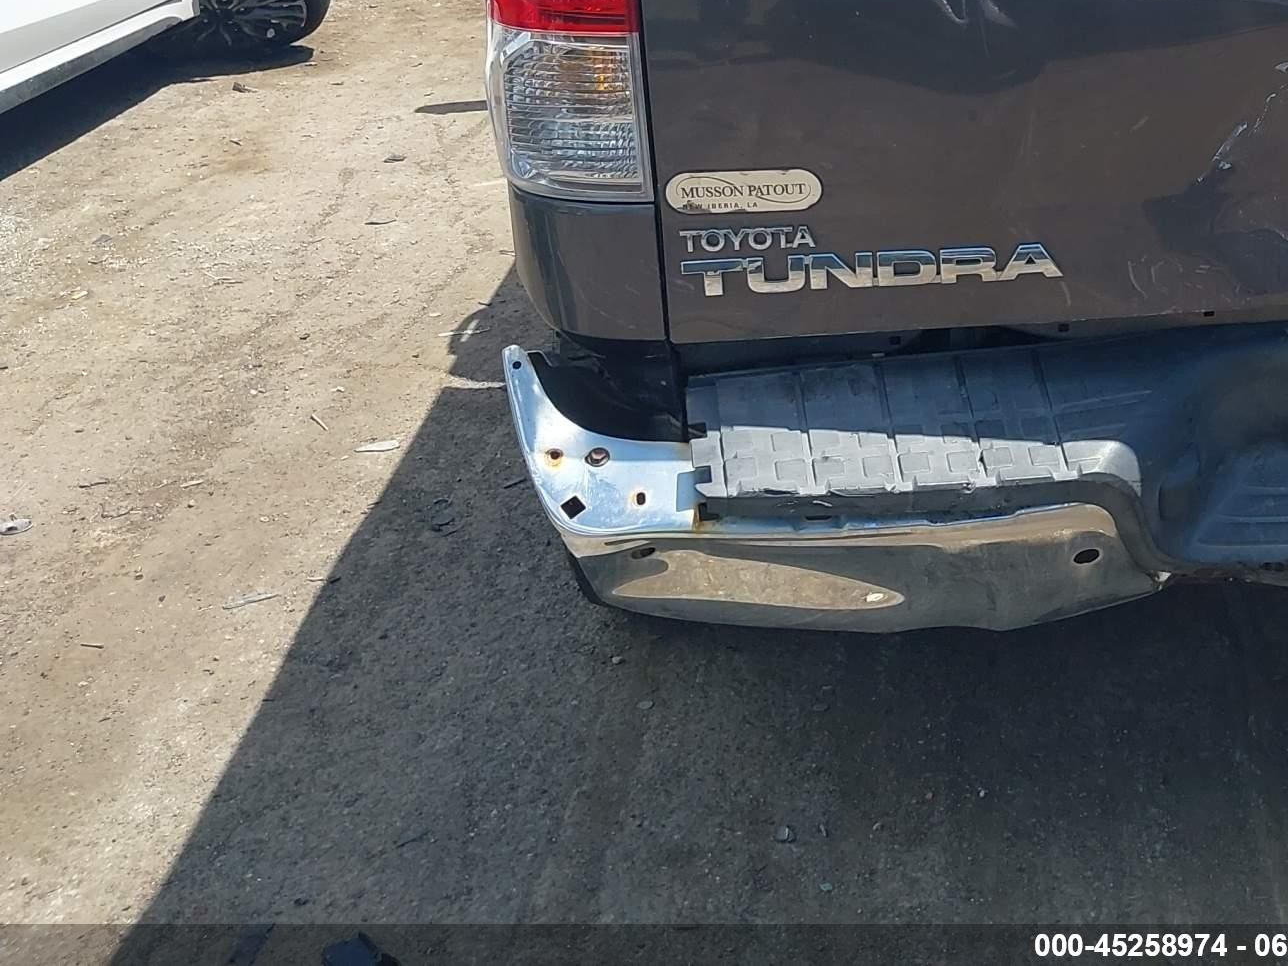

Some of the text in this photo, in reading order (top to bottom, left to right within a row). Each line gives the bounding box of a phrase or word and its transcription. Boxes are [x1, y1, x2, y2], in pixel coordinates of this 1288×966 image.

[681, 183, 806, 199] MUSSON PATOUT
[679, 226, 816, 253] TOYOTA
[680, 242, 1063, 296] TUNDRA
